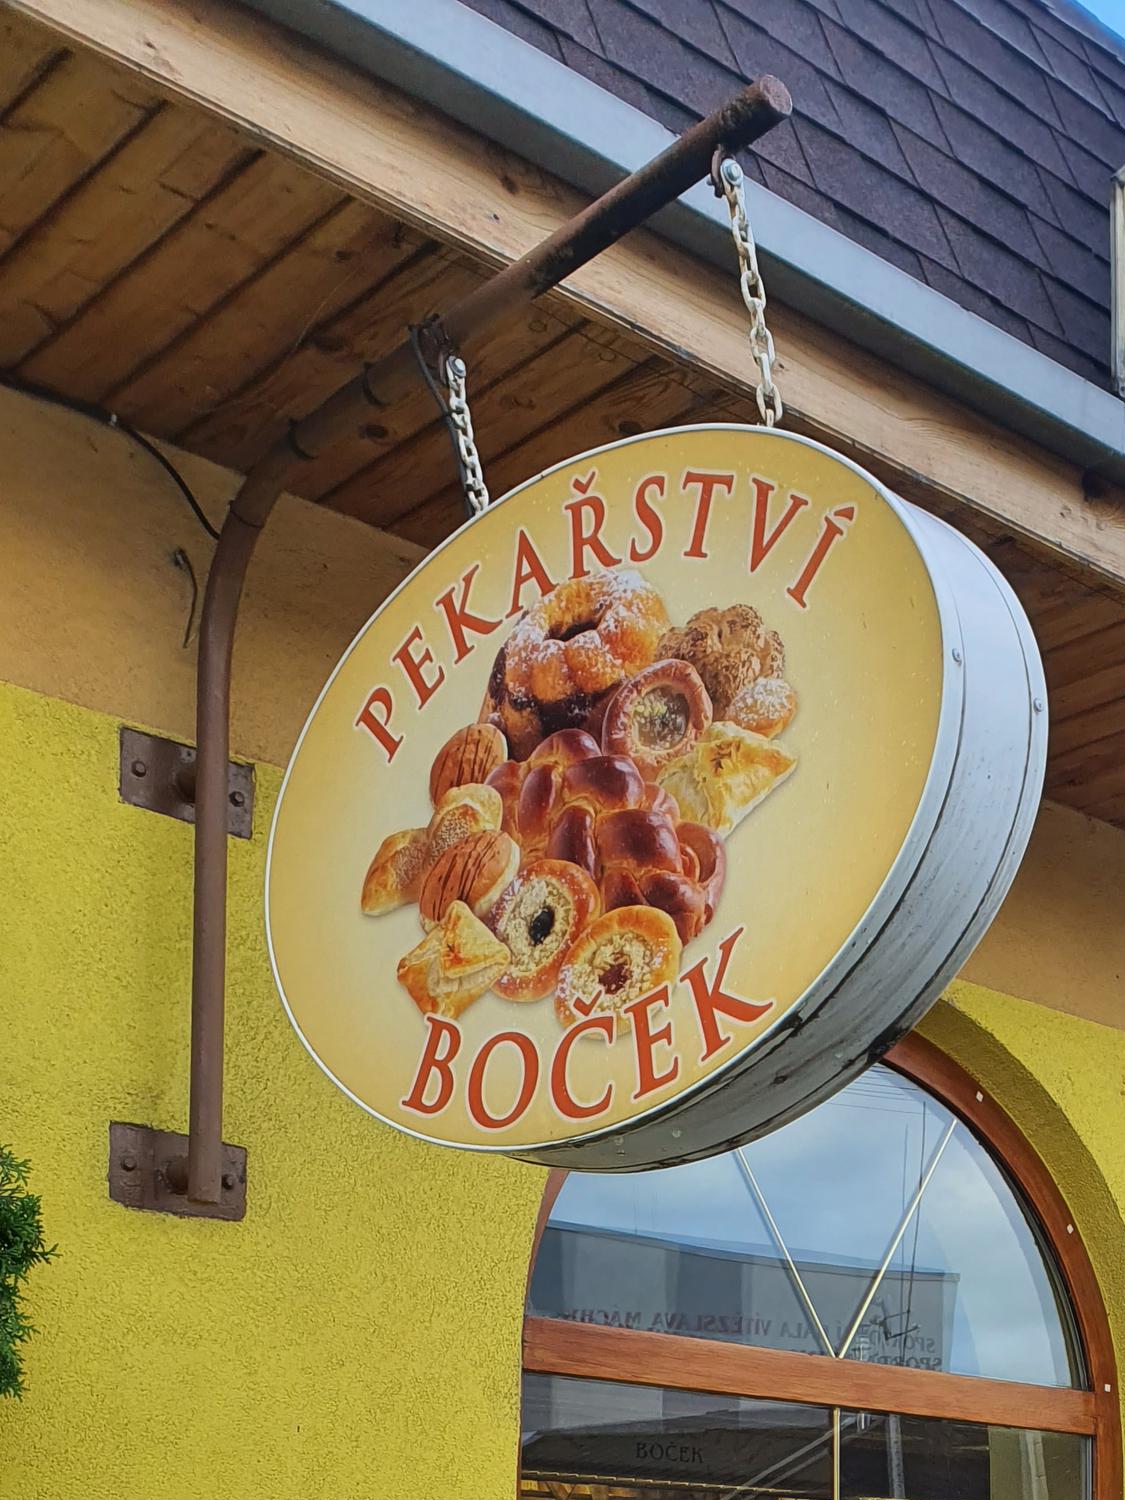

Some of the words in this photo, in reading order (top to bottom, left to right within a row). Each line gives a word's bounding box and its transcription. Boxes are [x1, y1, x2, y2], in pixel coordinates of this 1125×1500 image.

[355, 471, 857, 764] PEKAŘSTVÍ
[401, 927, 776, 1130] BOČEK
[635, 1441, 704, 1464] BOČEK
